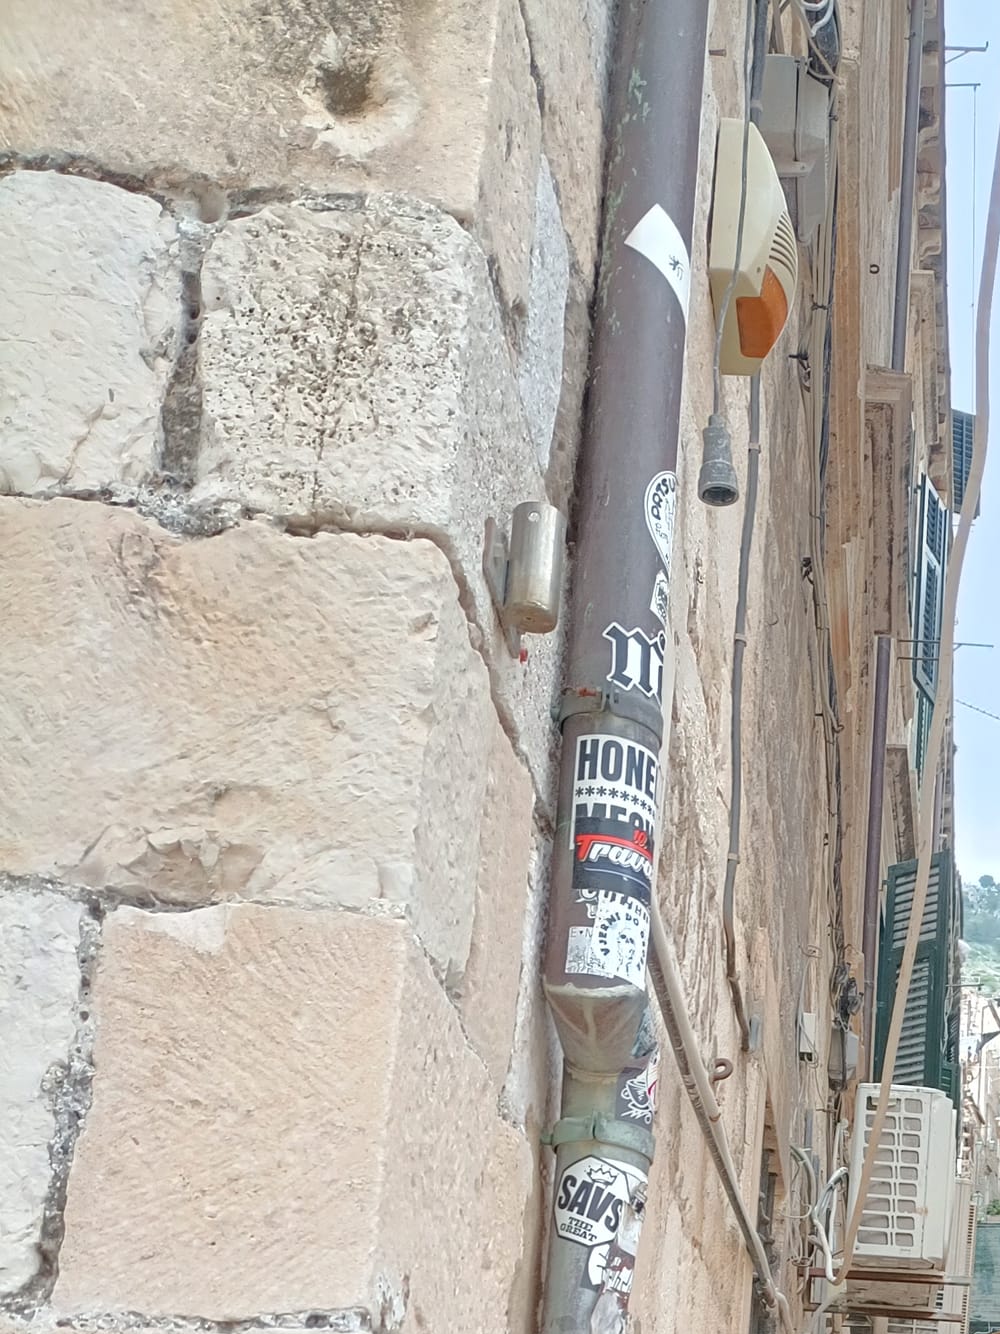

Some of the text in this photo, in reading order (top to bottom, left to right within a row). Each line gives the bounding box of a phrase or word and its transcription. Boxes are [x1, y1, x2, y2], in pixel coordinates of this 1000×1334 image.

[577, 738, 660, 801] HONE
[557, 1174, 624, 1234] SAVS
[559, 1223, 597, 1242] GREAT
[568, 1216, 593, 1232] THE
